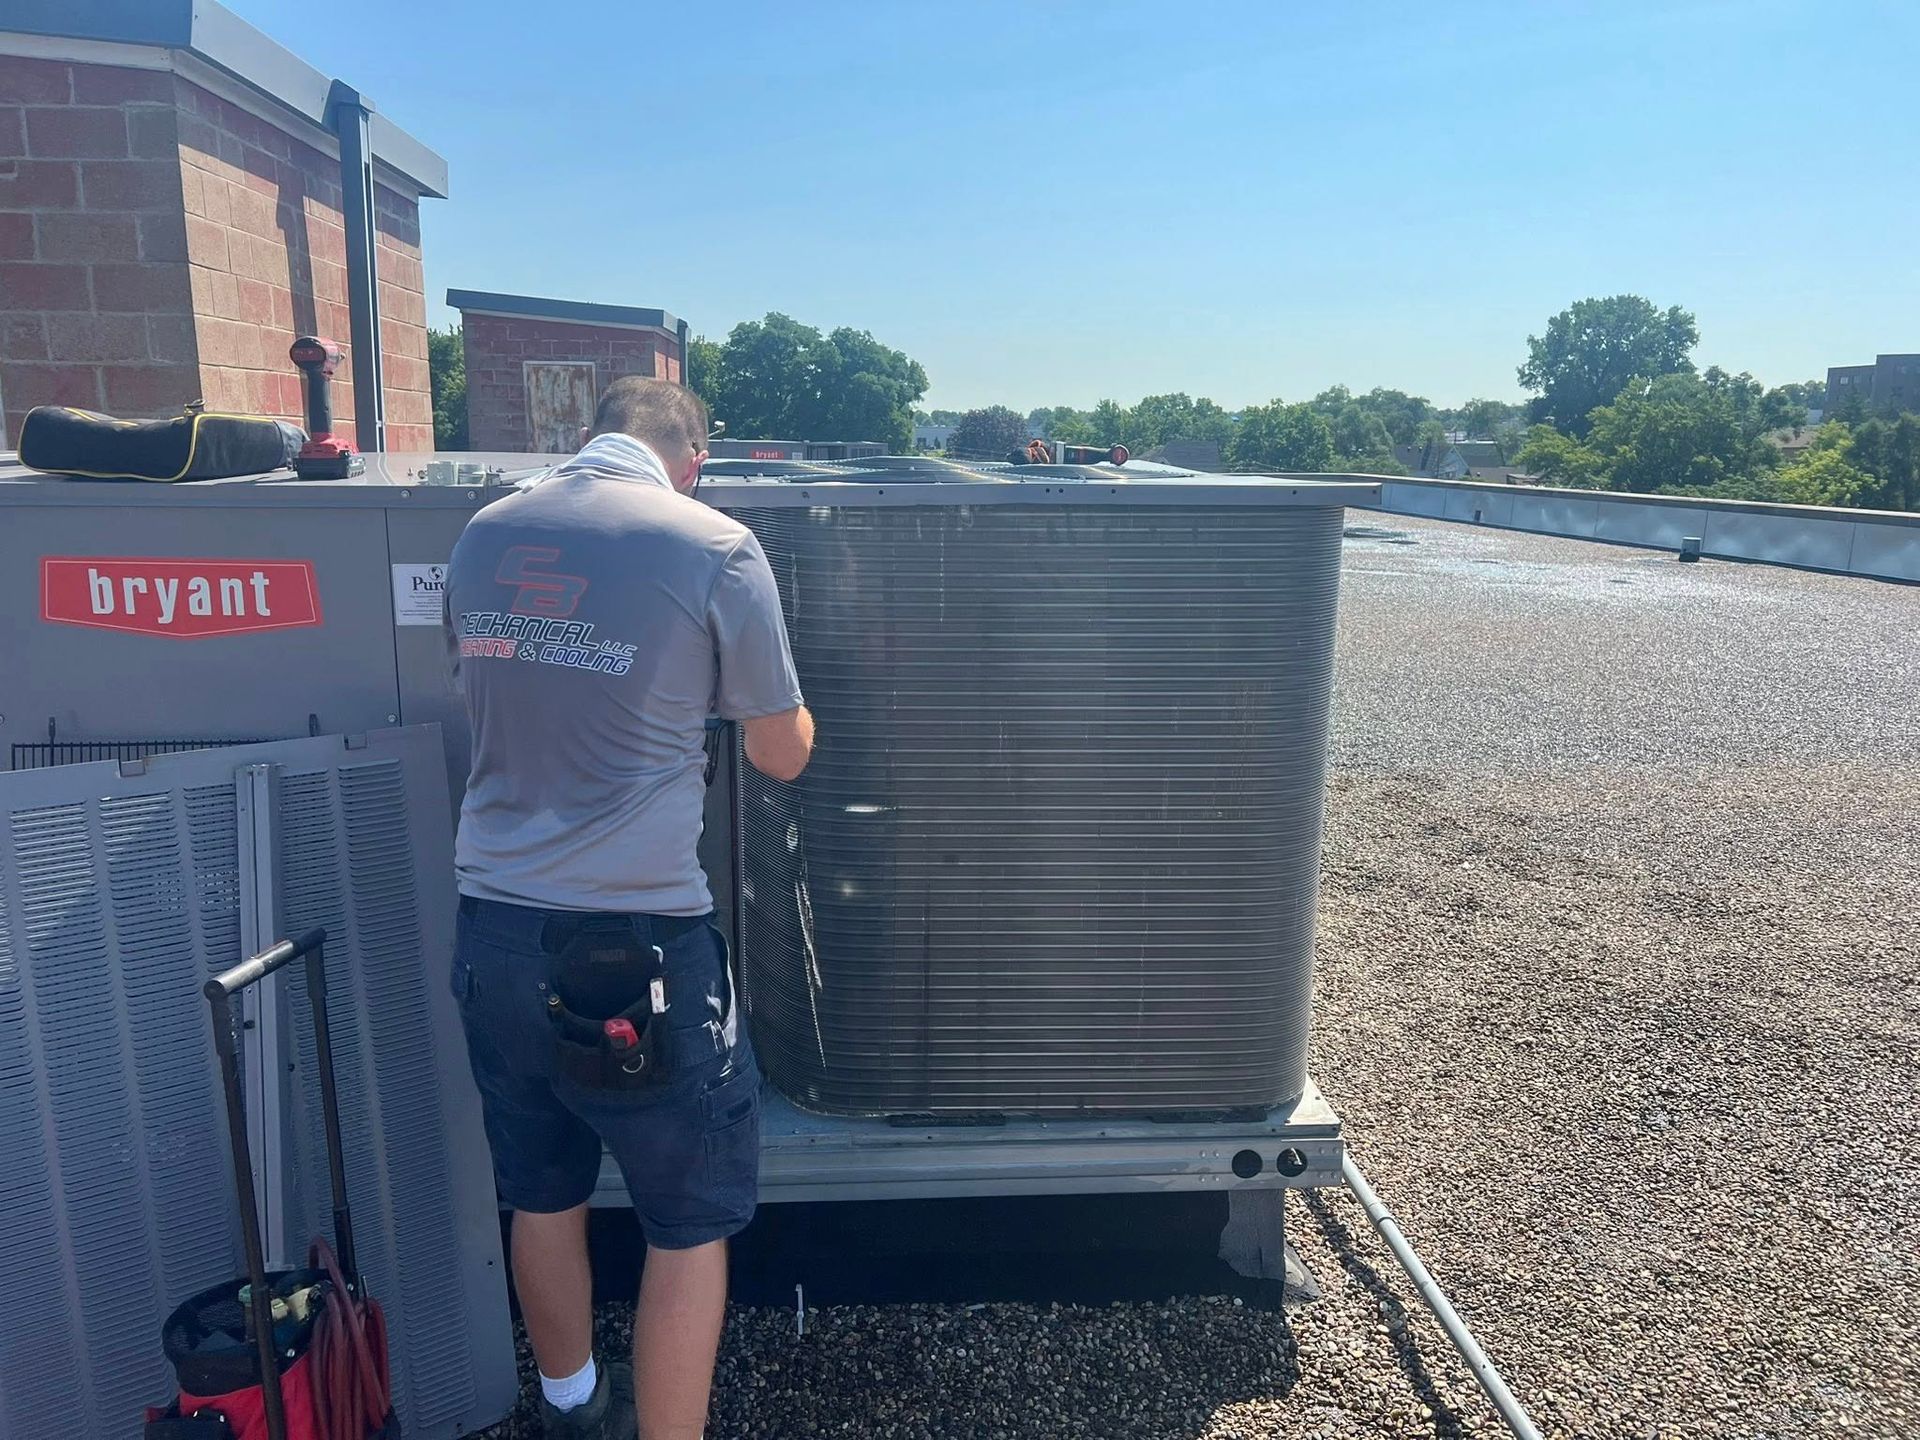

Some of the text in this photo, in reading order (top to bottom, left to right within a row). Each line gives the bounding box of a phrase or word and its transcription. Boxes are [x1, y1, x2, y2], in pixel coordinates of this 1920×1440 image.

[88, 568, 271, 624] bryant
[461, 637, 634, 675] EATING & COOLING
[601, 640, 637, 657] LLC
